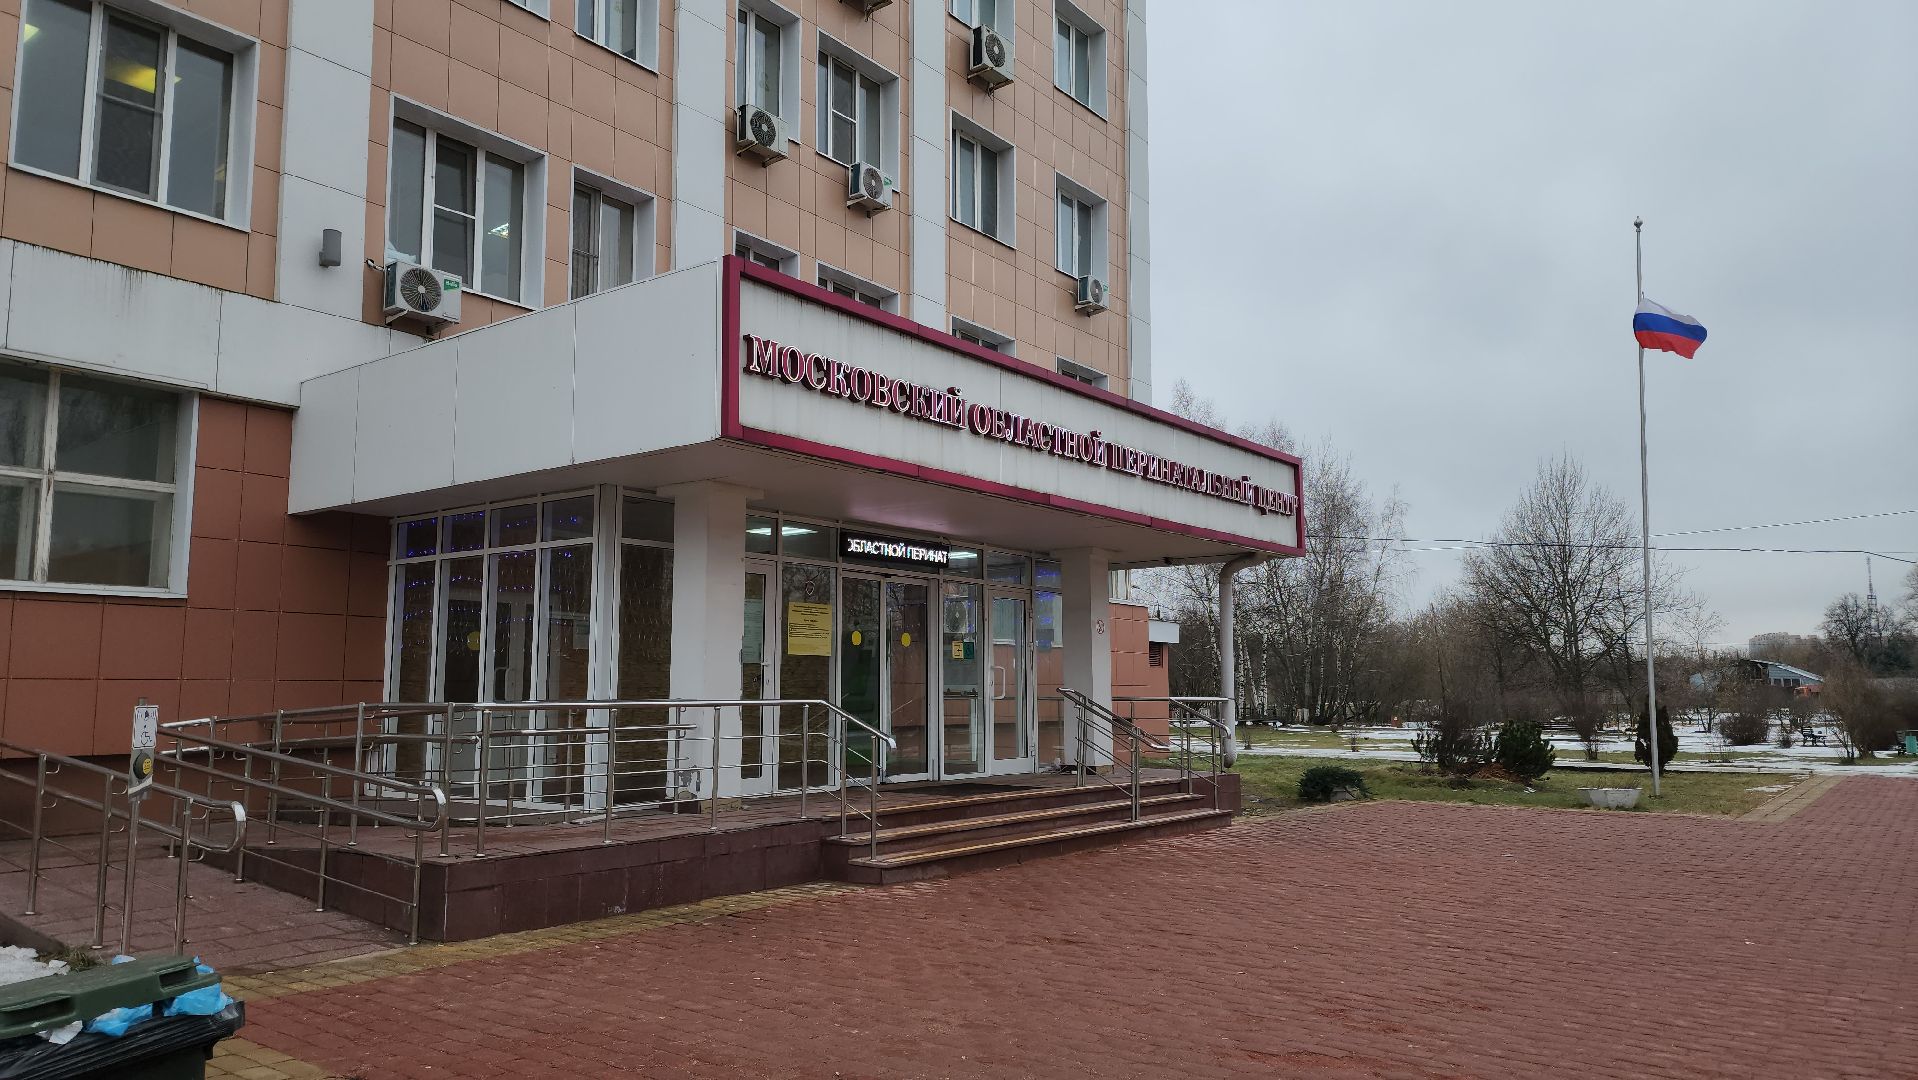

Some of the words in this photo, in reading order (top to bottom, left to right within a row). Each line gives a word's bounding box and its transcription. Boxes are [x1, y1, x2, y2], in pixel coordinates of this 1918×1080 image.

[743, 333, 967, 430] МОСКОВСКИЙ
[968, 403, 1107, 467] ОБЛАСТНОЙ
[1106, 441, 1256, 506] ПЕРИНАТАЛЬНЫЙ
[1257, 485, 1299, 516] ЦЕНТР
